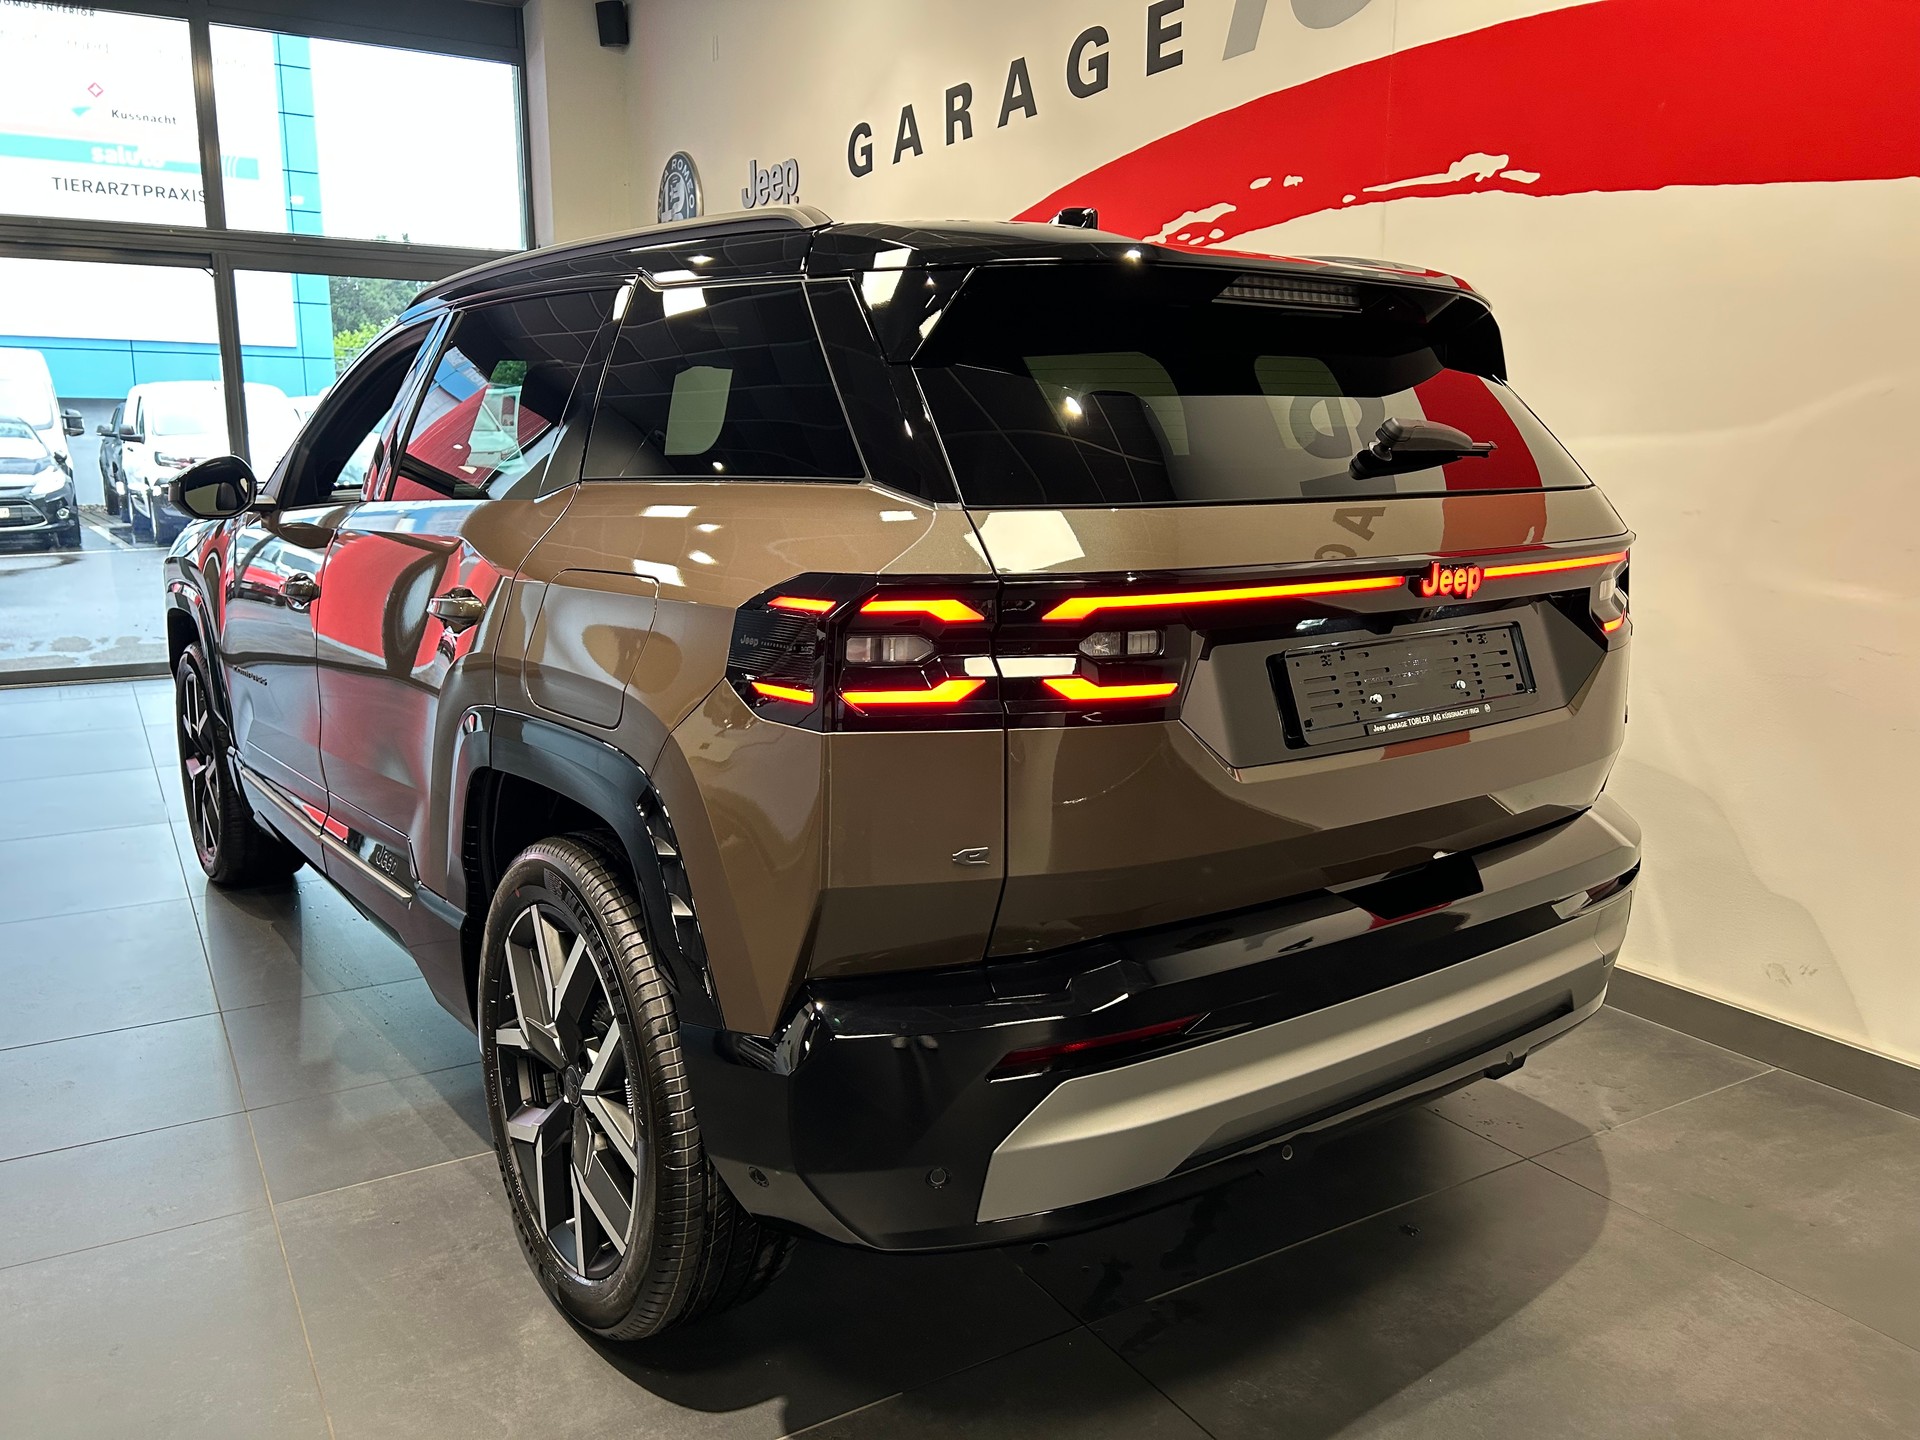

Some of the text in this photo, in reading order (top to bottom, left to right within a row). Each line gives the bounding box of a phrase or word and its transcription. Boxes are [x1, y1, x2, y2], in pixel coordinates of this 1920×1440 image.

[847, 0, 1185, 178] GARAGE
[52, 177, 206, 203] TIERARZTPRAXIS
[671, 158, 695, 209] ROMEO
[741, 158, 800, 209] Jeep
[1422, 561, 1482, 599] Jeep
[740, 634, 759, 647] Jeep
[1373, 724, 1387, 733] Jeep
[1387, 720, 1408, 730] GARAGE
[1407, 715, 1431, 727] TOBLER
[1432, 713, 1442, 722] AG
